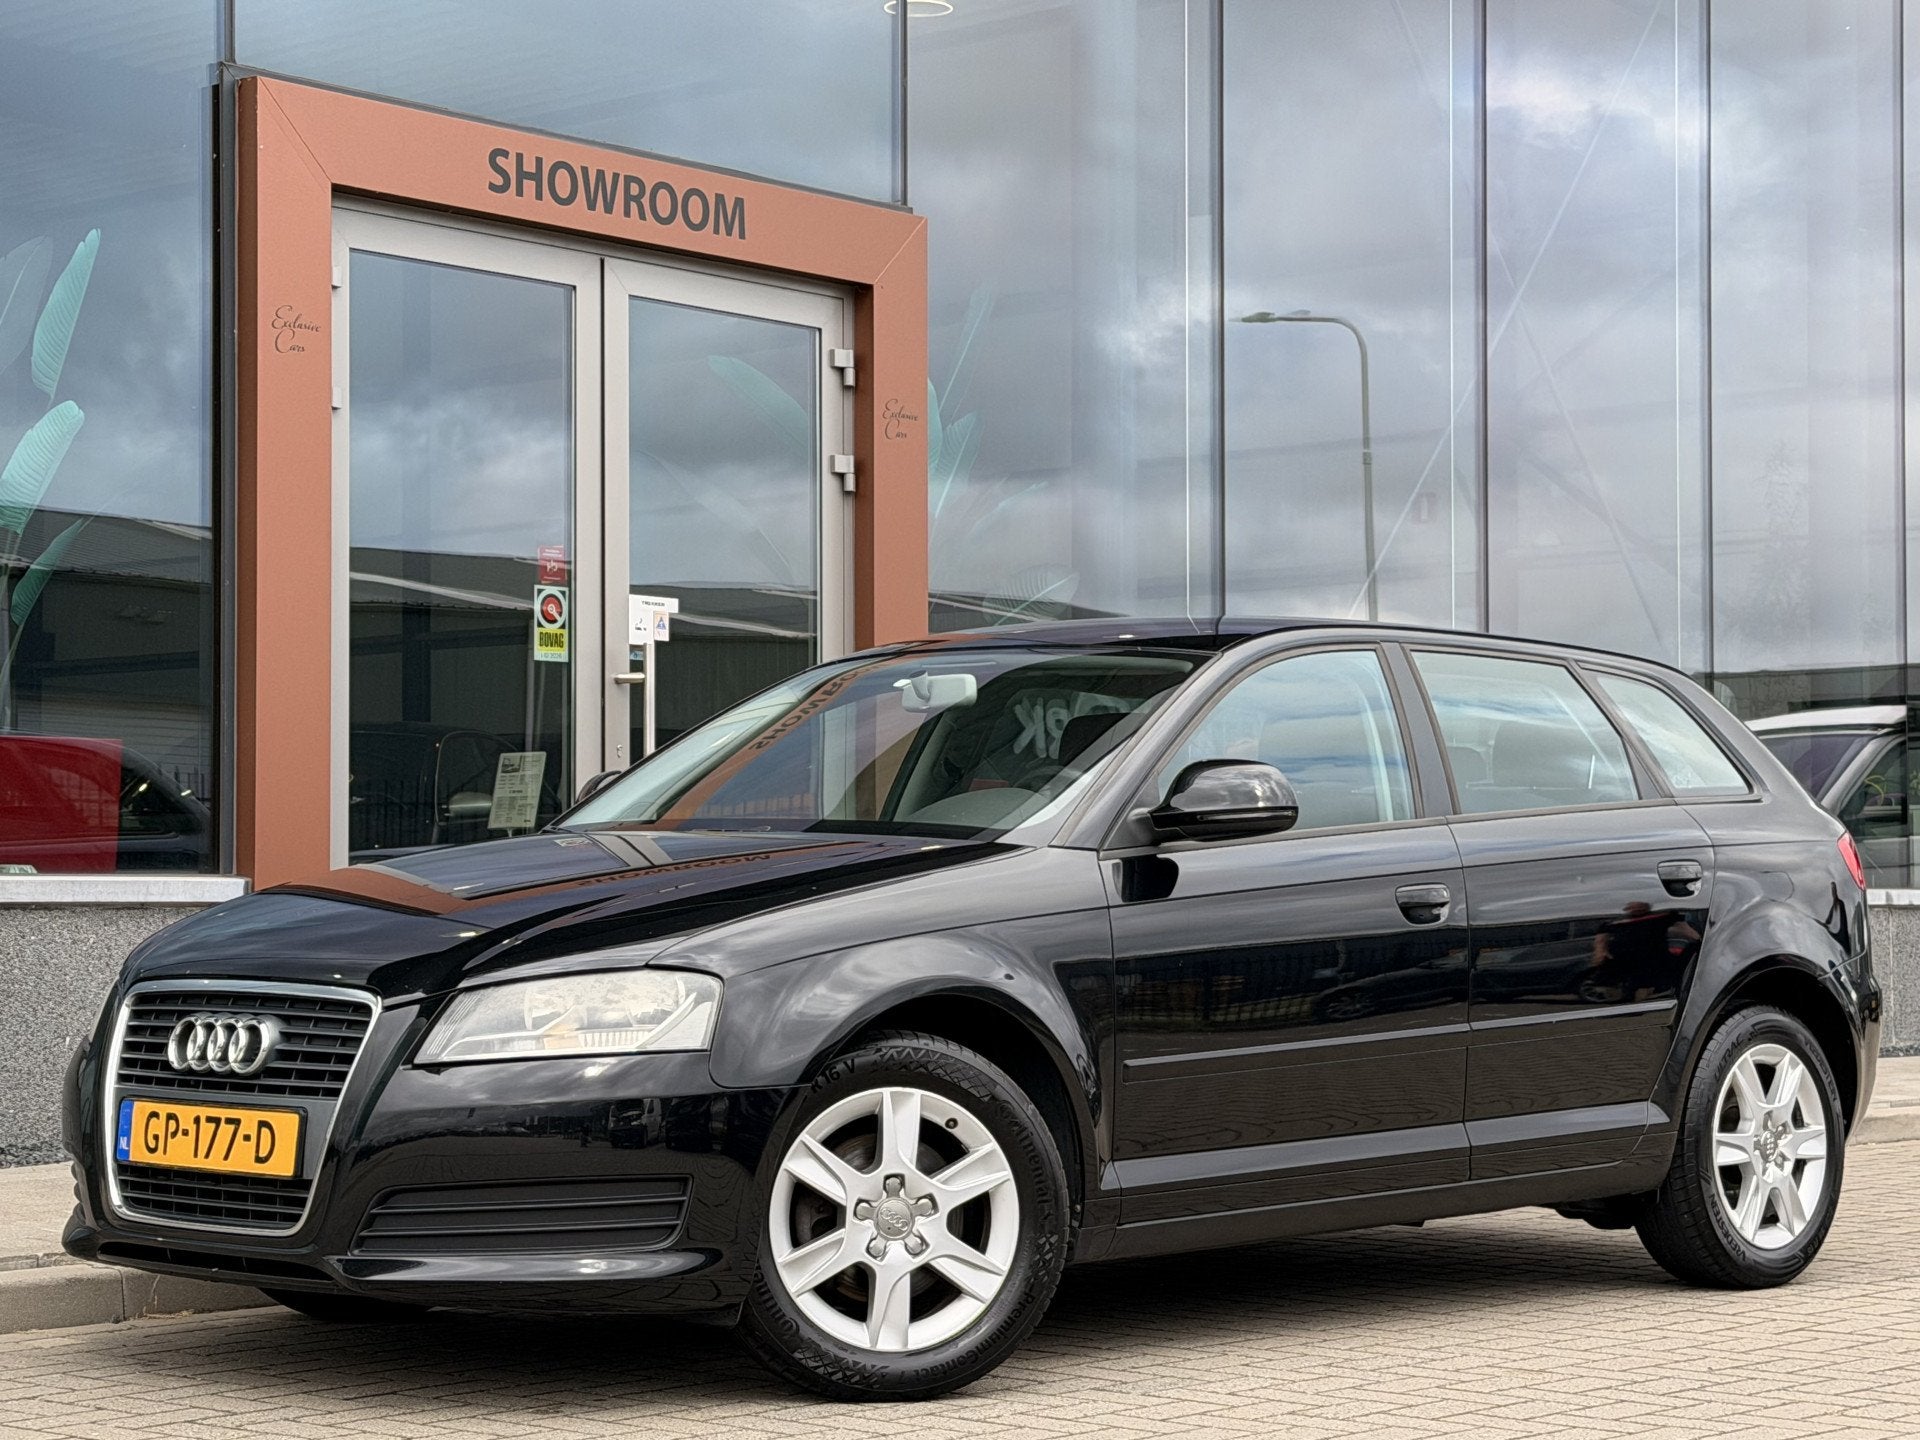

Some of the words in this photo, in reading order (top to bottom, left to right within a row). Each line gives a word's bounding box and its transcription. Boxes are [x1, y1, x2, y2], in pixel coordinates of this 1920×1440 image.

[487, 147, 746, 240] SHOWROOM
[275, 328, 305, 353] Cars
[539, 632, 564, 648] BOVAG
[119, 1136, 129, 1150] NL
[144, 1110, 276, 1165] GP-177-D
[1709, 1194, 1747, 1261] VREDESTEIN
[912, 1291, 1037, 1378] PremiumContact
